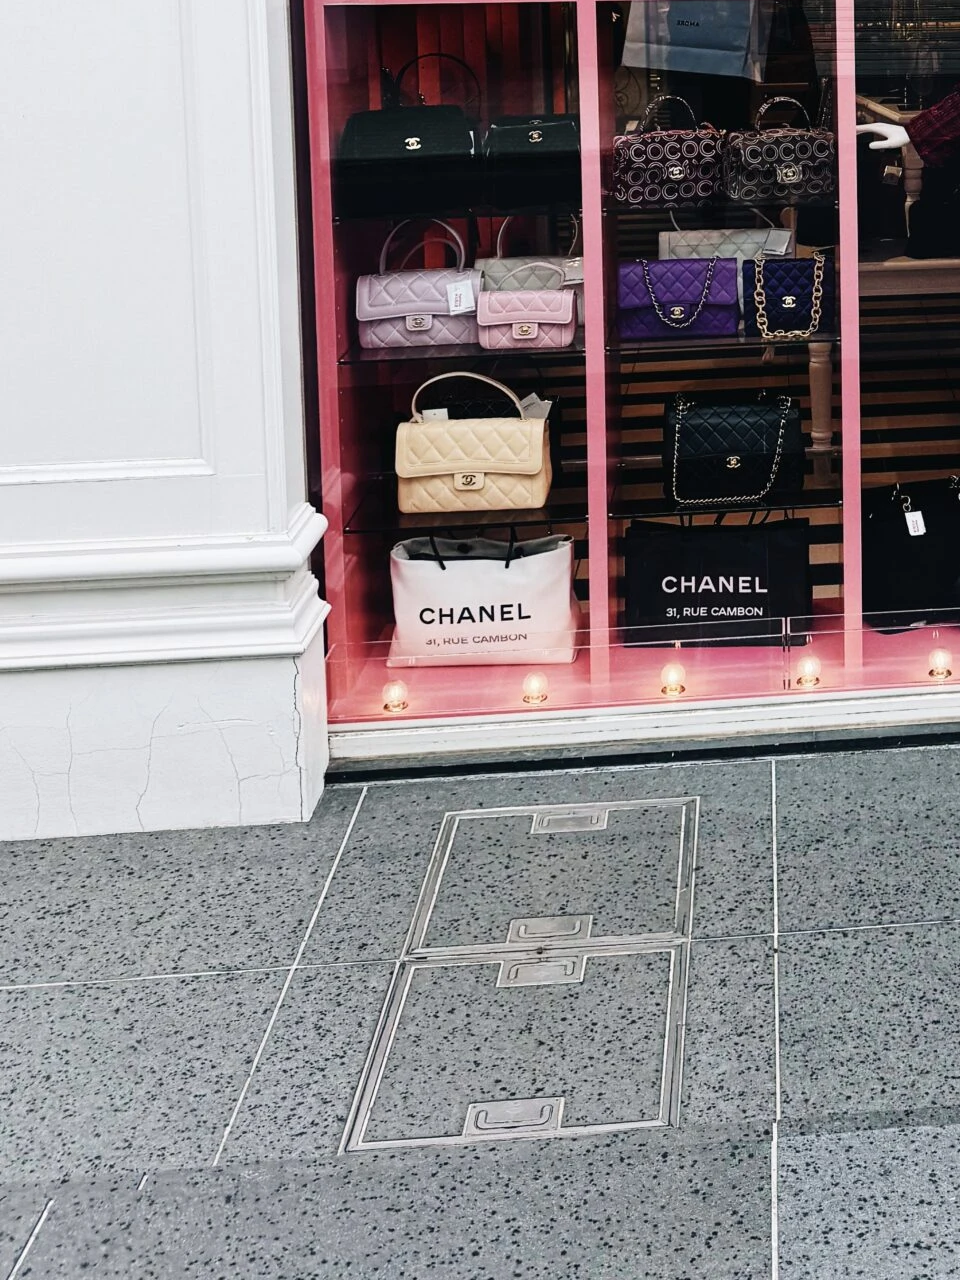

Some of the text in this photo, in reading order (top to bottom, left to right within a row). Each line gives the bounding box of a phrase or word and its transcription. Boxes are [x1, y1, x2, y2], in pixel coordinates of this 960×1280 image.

[661, 575, 768, 594] CHANEL
[419, 603, 532, 625] CHANEL
[665, 606, 764, 619] 31, RUE CAMBON
[443, 636, 469, 646] RUE
[472, 633, 528, 645] CAMBON
